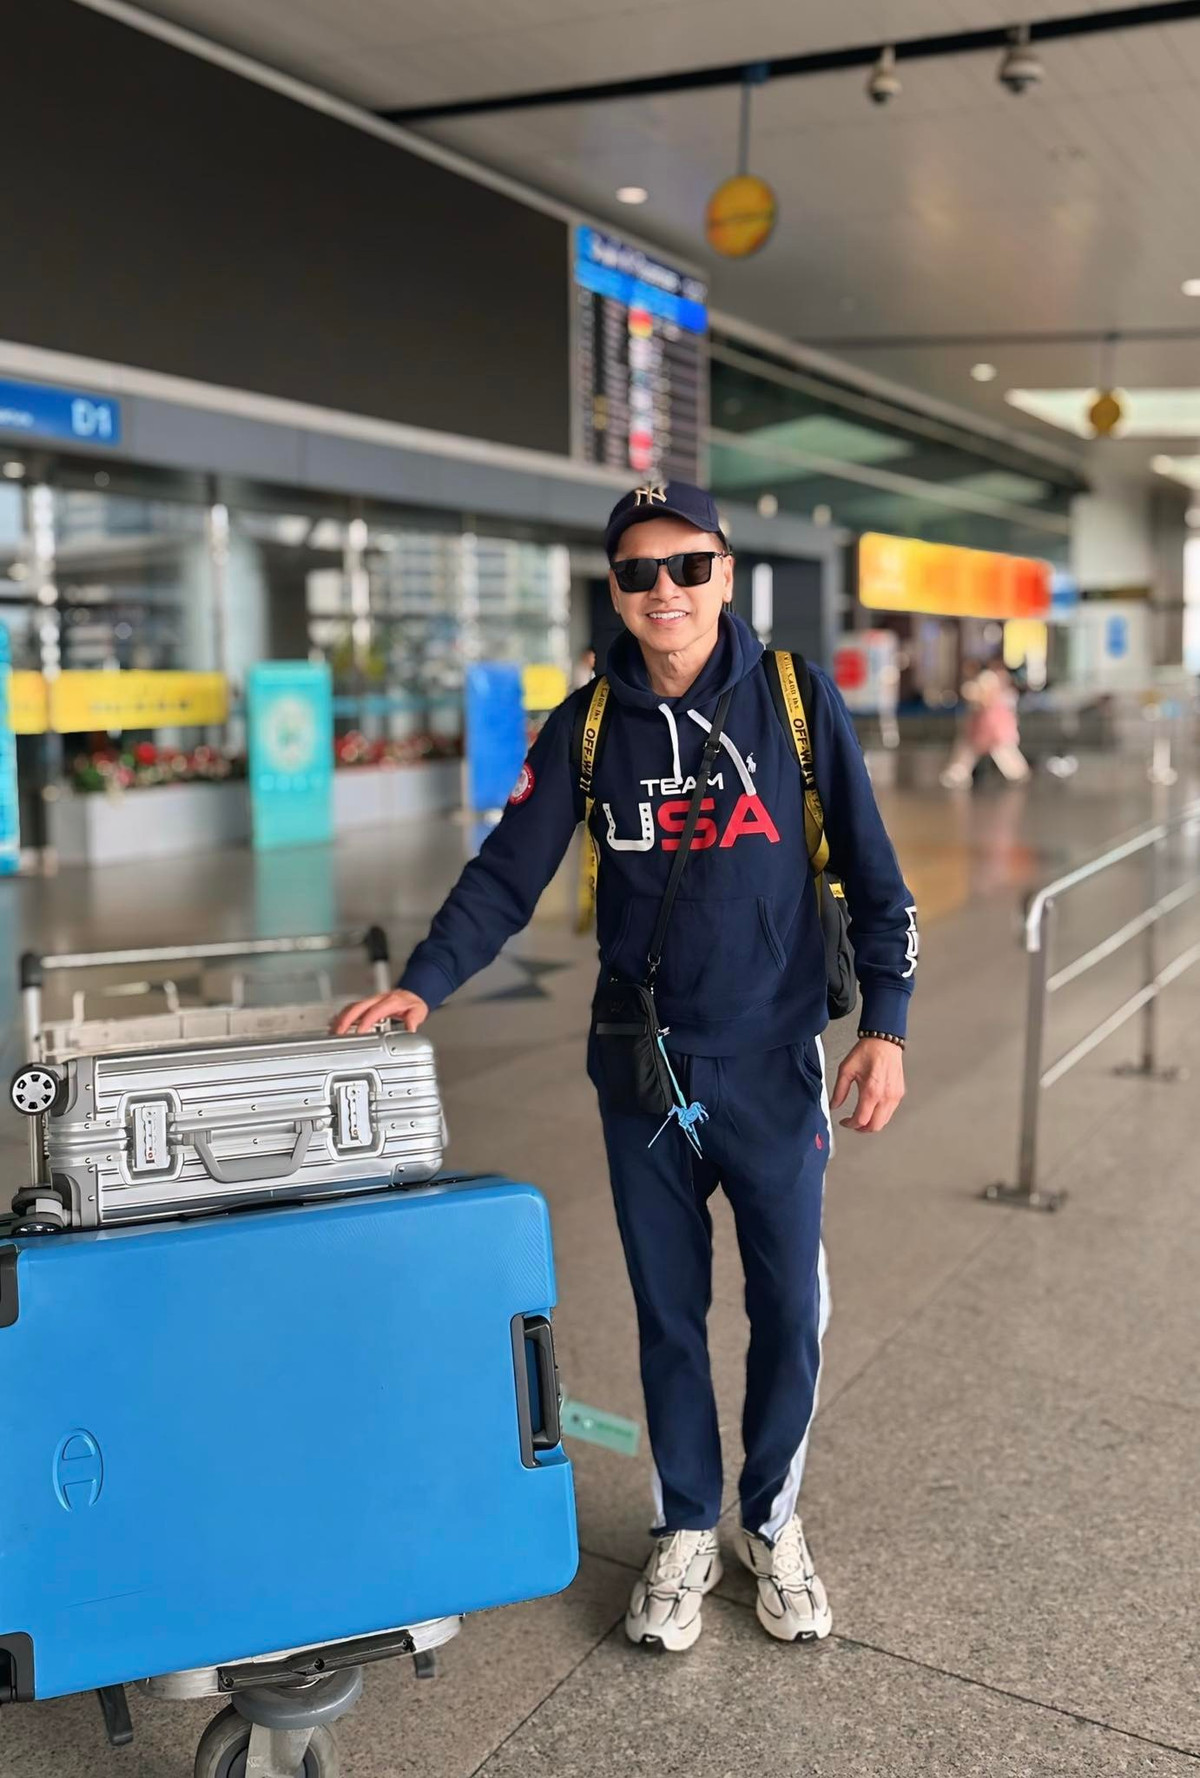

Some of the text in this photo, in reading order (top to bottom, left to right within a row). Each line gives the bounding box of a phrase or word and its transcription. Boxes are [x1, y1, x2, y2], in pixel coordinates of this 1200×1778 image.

[70, 398, 112, 438] D1
[640, 772, 724, 797] TEAM
[602, 794, 781, 852] USA
